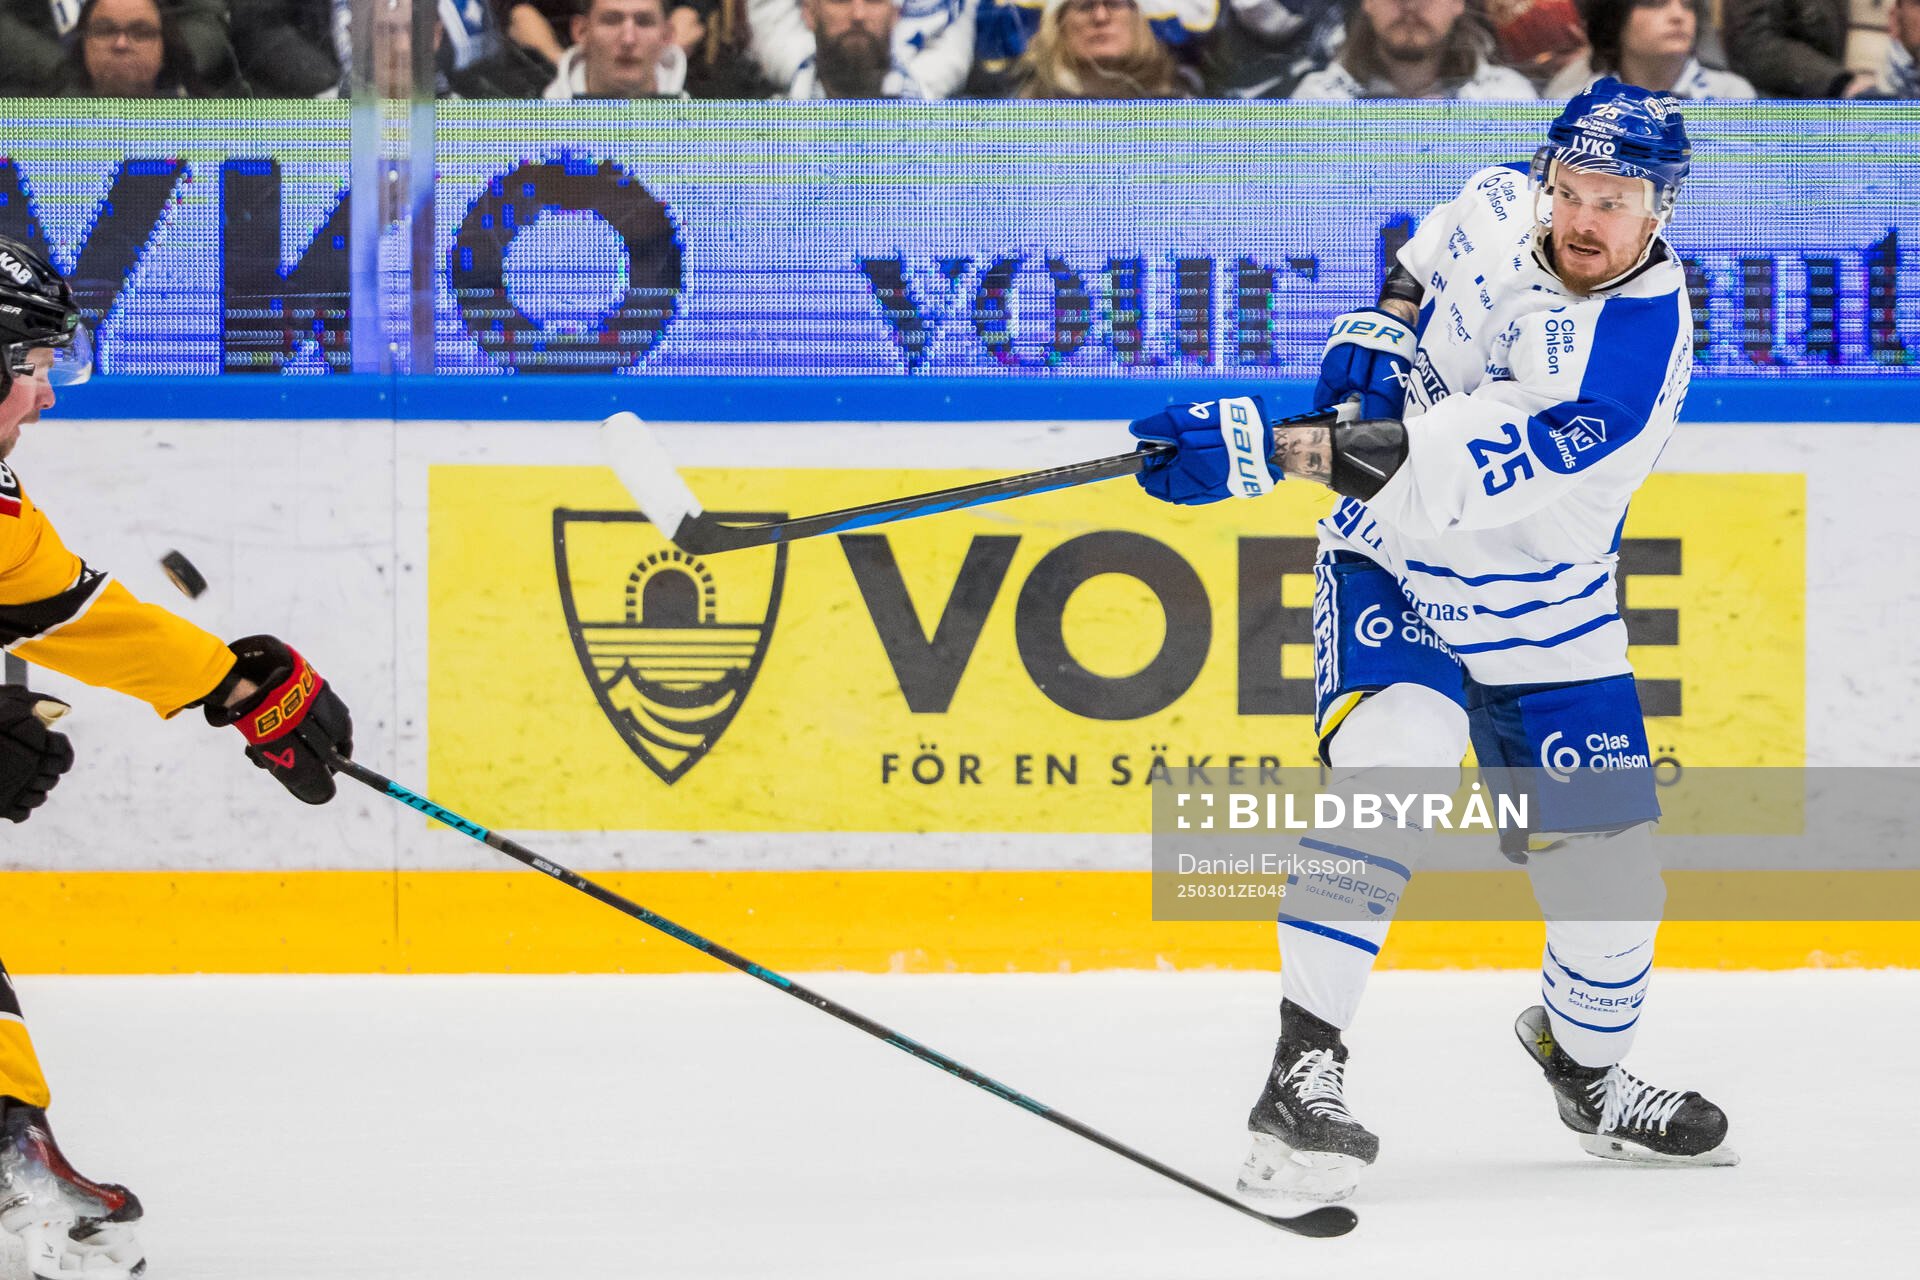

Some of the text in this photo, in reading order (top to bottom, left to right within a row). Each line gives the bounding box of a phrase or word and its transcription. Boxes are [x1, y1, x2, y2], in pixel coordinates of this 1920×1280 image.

[1572, 135, 1616, 157] LYKO
[857, 250, 1319, 375] your
[1545, 319, 1560, 375] Ohlson
[1561, 319, 1576, 353] Clas
[1466, 422, 1535, 496] 25
[1586, 732, 1630, 752] Clas
[881, 743, 983, 786] FÖR
[1015, 753, 1078, 786] EN
[1111, 744, 1283, 787] SÄKER
[1589, 751, 1649, 774] Ohlson
[1305, 884, 1355, 905] SOLENERGI
[1309, 868, 1400, 906] HYBRIDA
